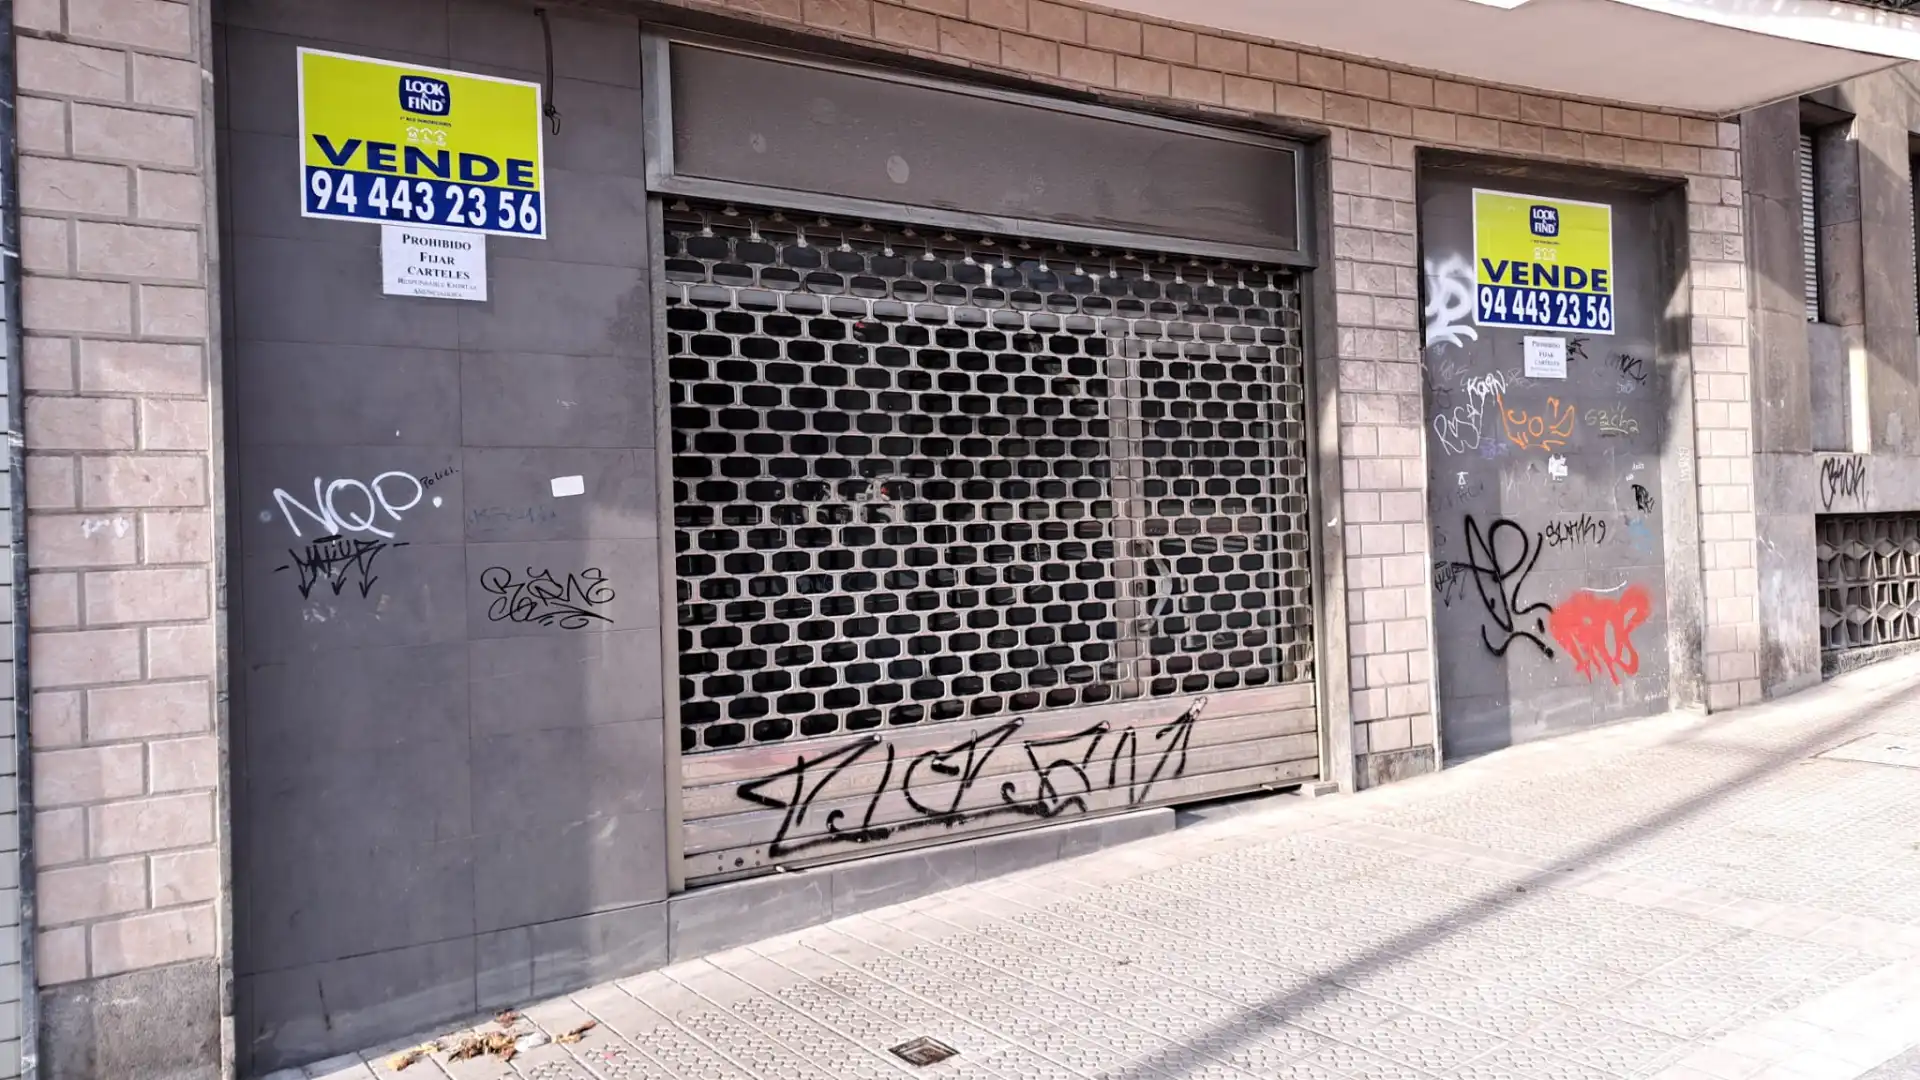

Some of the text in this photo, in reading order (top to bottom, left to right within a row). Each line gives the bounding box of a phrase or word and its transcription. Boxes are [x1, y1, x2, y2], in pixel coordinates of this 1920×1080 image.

[405, 79, 445, 97] LOOK
[408, 96, 444, 112] FIND
[312, 134, 534, 188] VENDE
[312, 170, 538, 232] 94 443 23 56
[1532, 208, 1556, 221] LOOK
[1534, 222, 1556, 234] FIND
[402, 233, 471, 251] PROHIBIDO
[420, 251, 454, 265] FIJAR
[407, 266, 470, 280] CARTELES
[1481, 258, 1608, 292] VENDE
[1481, 286, 1610, 329] 94 443 23 56
